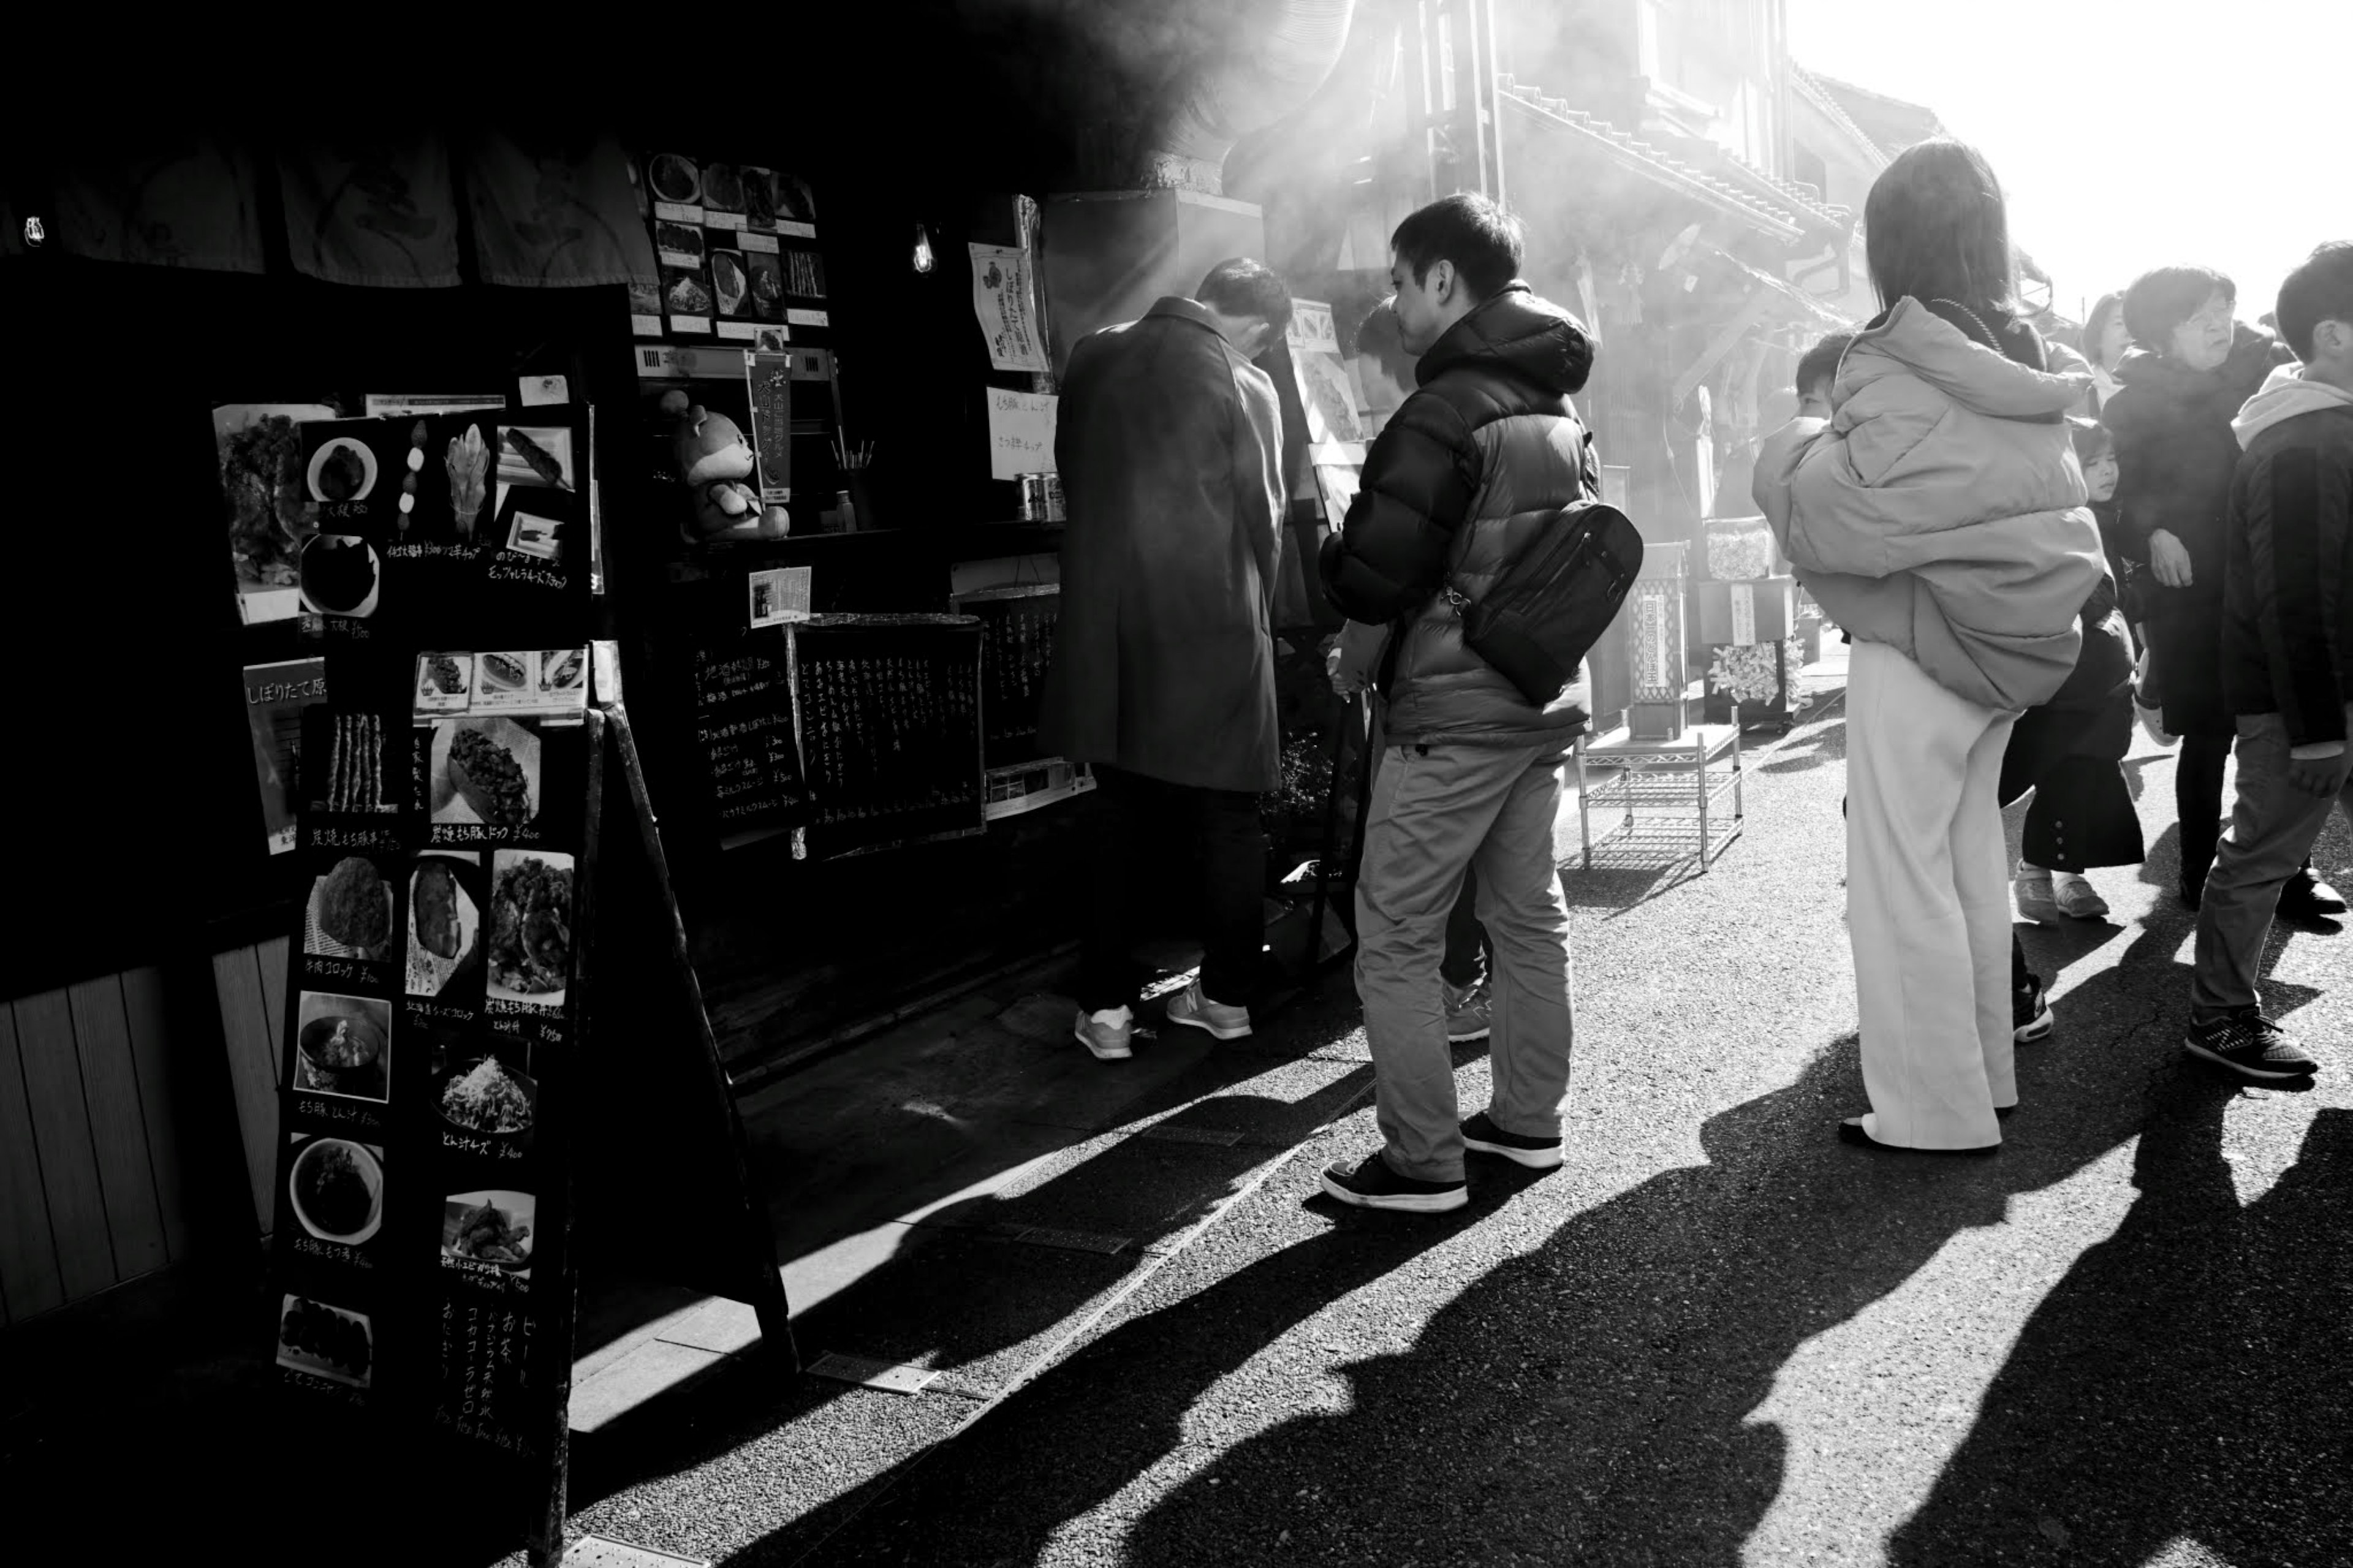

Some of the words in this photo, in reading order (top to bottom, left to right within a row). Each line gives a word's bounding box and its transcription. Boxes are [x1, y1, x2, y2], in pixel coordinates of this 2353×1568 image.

[463, 1306, 479, 1415] コカコーラゼロ
